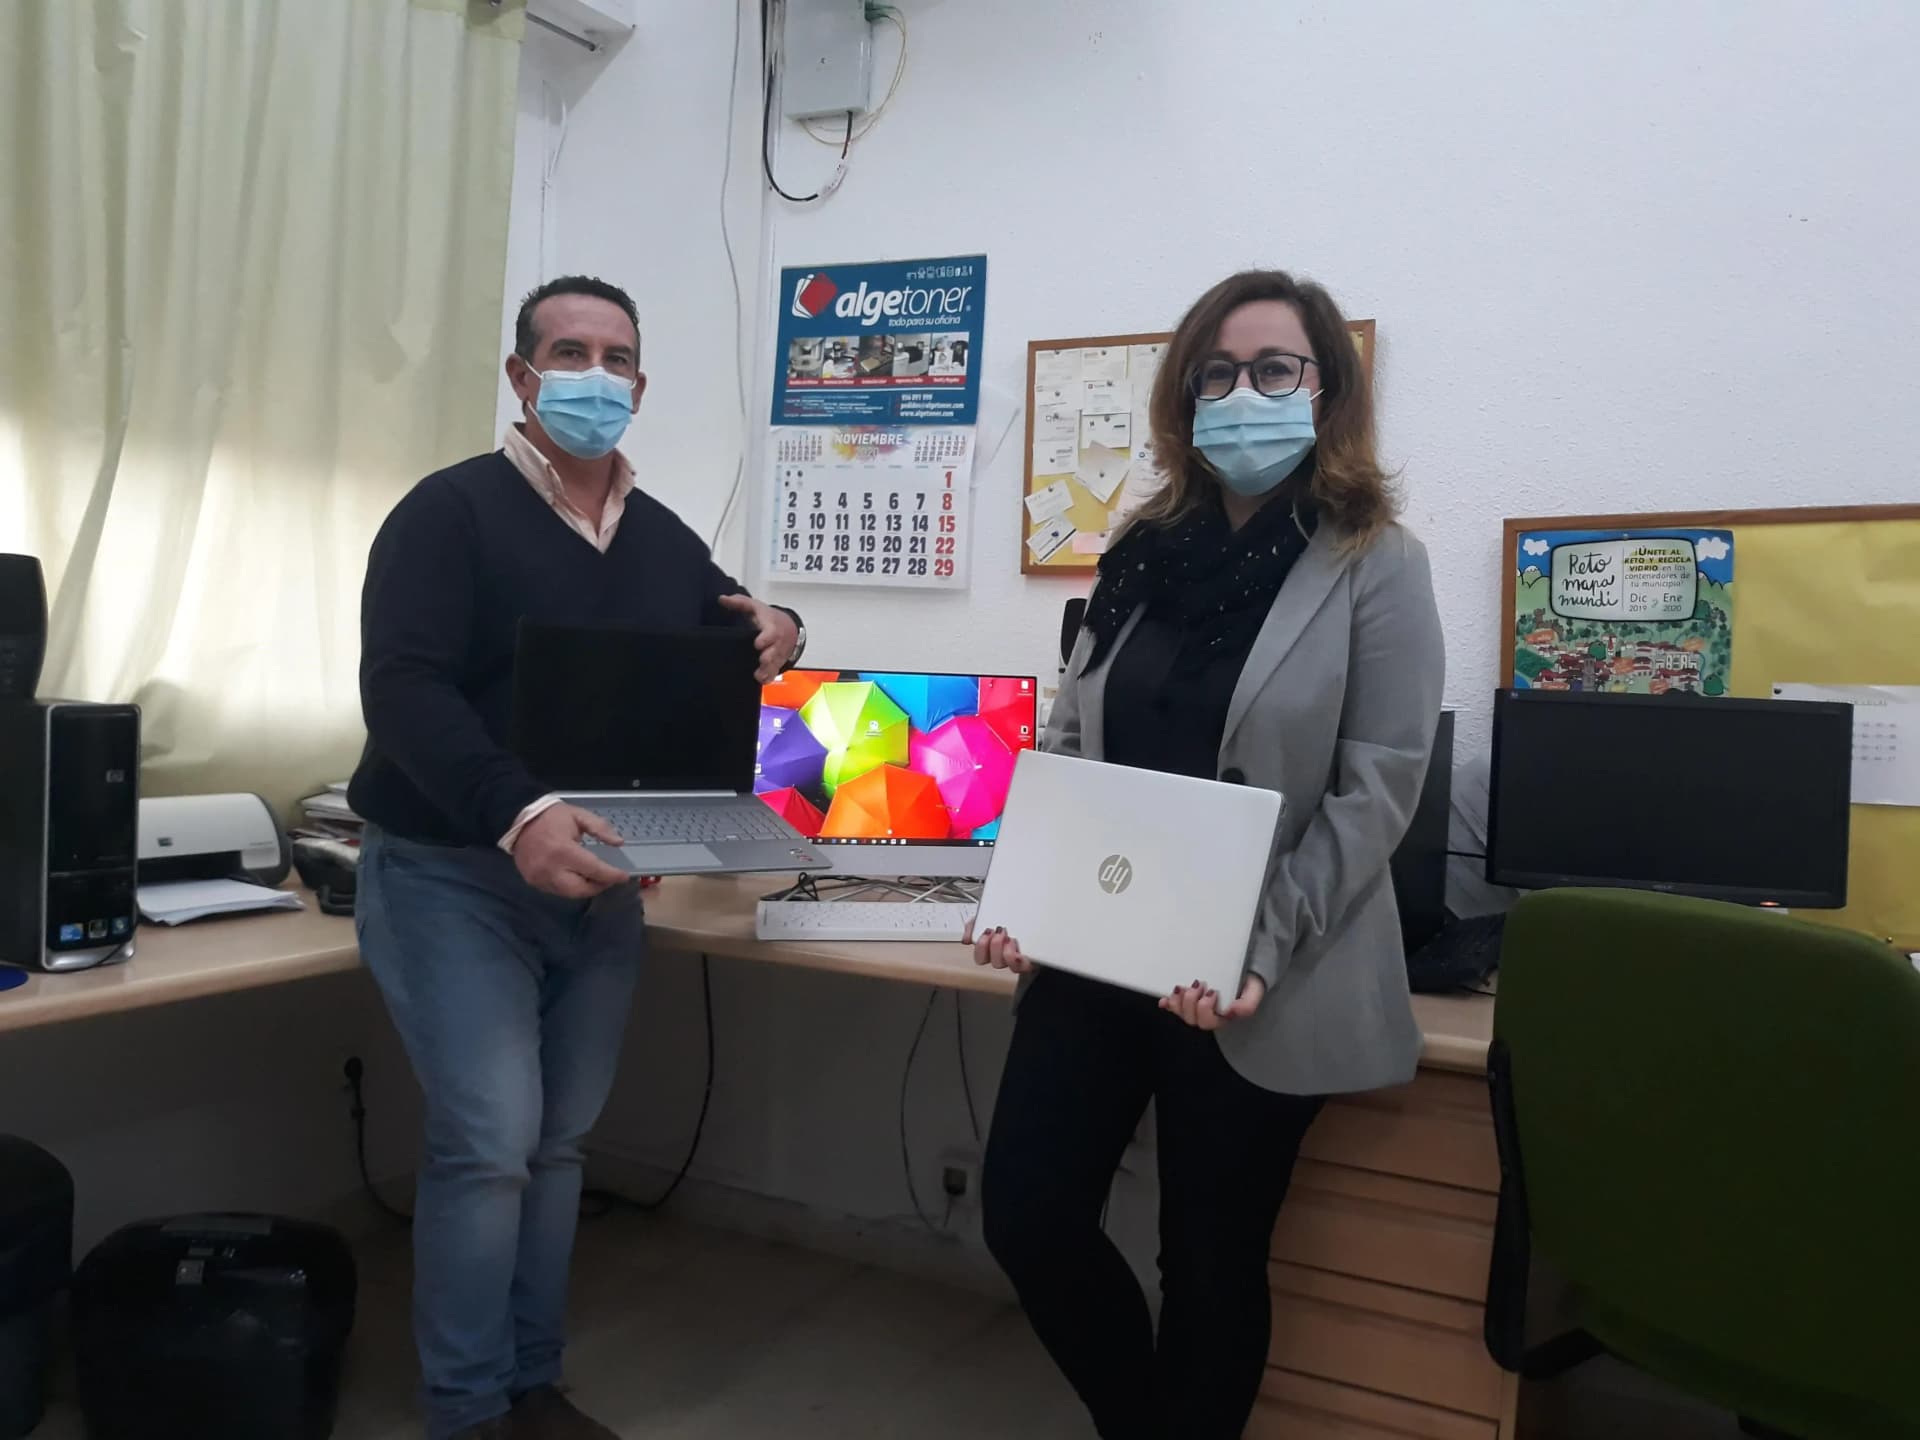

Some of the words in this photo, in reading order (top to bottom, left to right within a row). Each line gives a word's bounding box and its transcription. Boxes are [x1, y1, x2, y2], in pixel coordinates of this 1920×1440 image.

[835, 281, 972, 326] algetoner
[889, 318, 906, 327] todo
[906, 318, 924, 328] para
[925, 317, 934, 326] su
[934, 314, 960, 325] oficina
[834, 433, 904, 446] NOVIEMBRE
[945, 471, 953, 489] 1
[788, 491, 798, 508] 2
[812, 491, 822, 509] 3
[837, 492, 848, 509] 4
[863, 492, 873, 510] 5
[888, 492, 899, 510] 6
[916, 493, 926, 510] 7
[942, 493, 953, 511] 8
[786, 512, 797, 529] 9
[809, 513, 826, 530] 10
[835, 513, 850, 531] 11
[860, 514, 877, 531] 12
[886, 514, 903, 532] 13
[911, 515, 929, 533] 14
[938, 515, 956, 533] 15
[783, 532, 800, 550] 16
[808, 533, 825, 550] 17
[833, 534, 850, 552] 18
[859, 535, 876, 553] 19
[882, 536, 902, 553] 20
[909, 536, 927, 554] 21
[935, 537, 955, 555] 22
[804, 554, 824, 572] 24
[830, 556, 849, 573] 25
[855, 557, 875, 574] 26
[881, 557, 901, 575] 27
[907, 558, 928, 576] 28
[934, 559, 954, 577] 29
[1569, 552, 1612, 576] Reto
[1624, 556, 1645, 564] RETO
[1658, 556, 1692, 564] RECICLA
[1562, 575, 1615, 596] mapa
[1558, 591, 1619, 608] mundi
[1630, 593, 1648, 603] Dic
[1663, 592, 1683, 603] Ene
[1628, 604, 1648, 612] 2019
[1663, 604, 1682, 612] 2020
